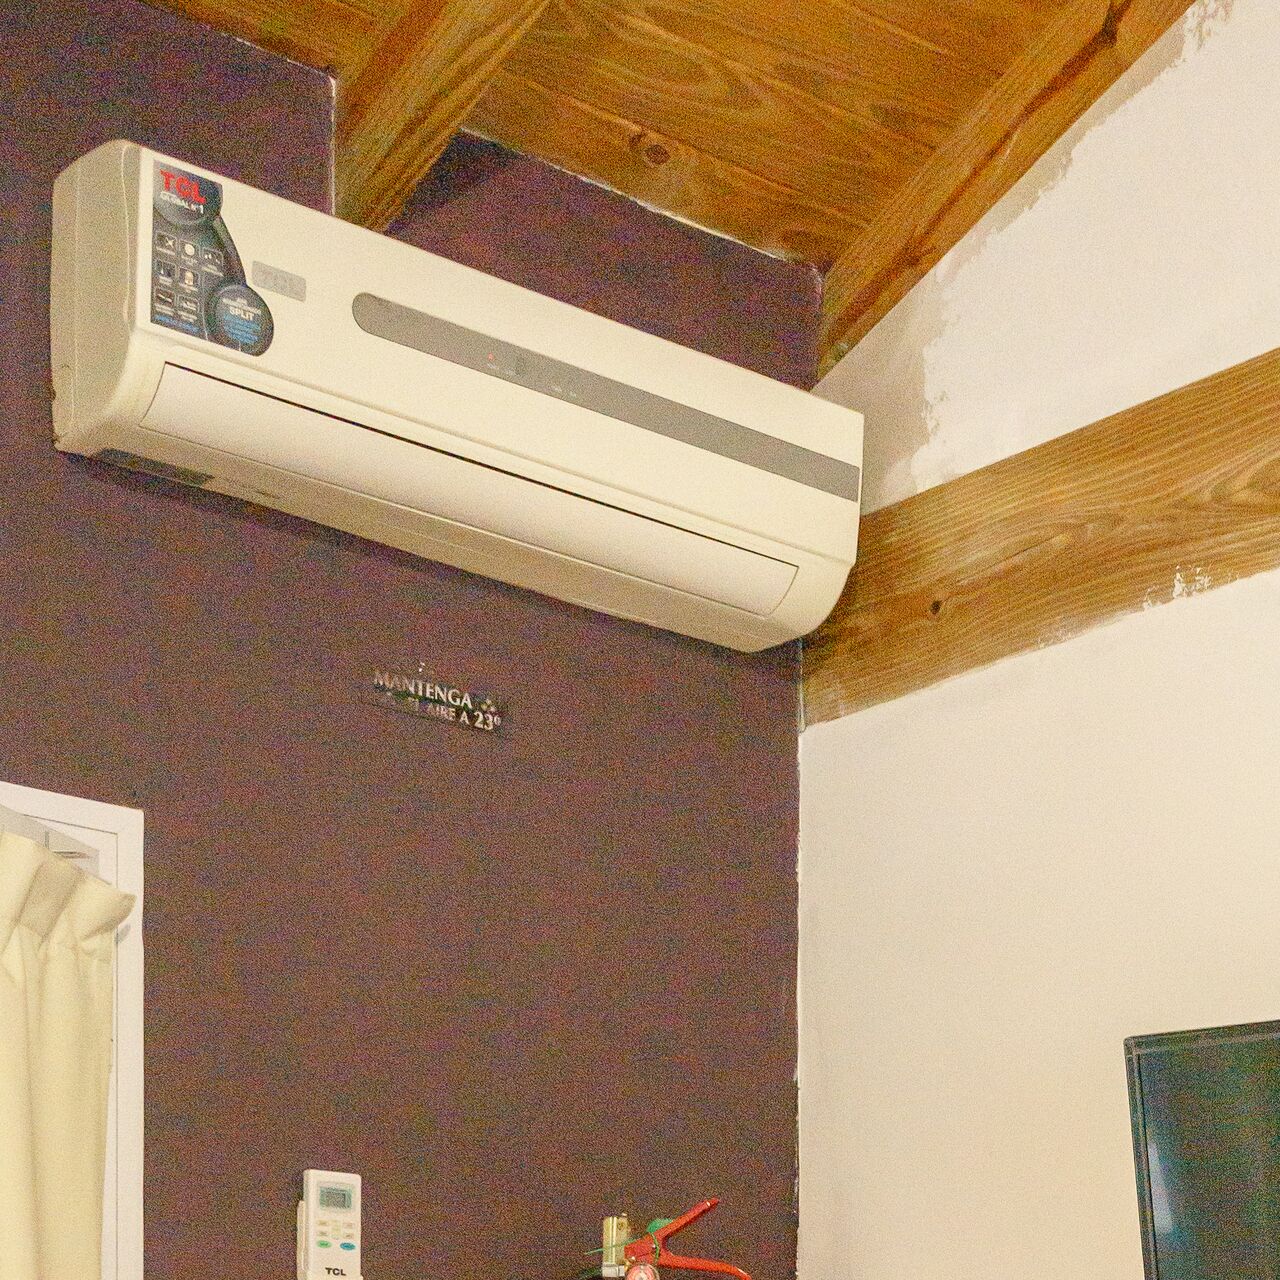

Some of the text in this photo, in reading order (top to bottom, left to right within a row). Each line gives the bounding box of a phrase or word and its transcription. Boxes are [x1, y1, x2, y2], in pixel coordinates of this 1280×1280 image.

[160, 168, 207, 205] TCL
[229, 305, 255, 321] SPLIT
[373, 670, 473, 710] MANTENGA
[426, 702, 457, 721] AIRE
[459, 711, 470, 726] A
[325, 1267, 347, 1277] TCL
